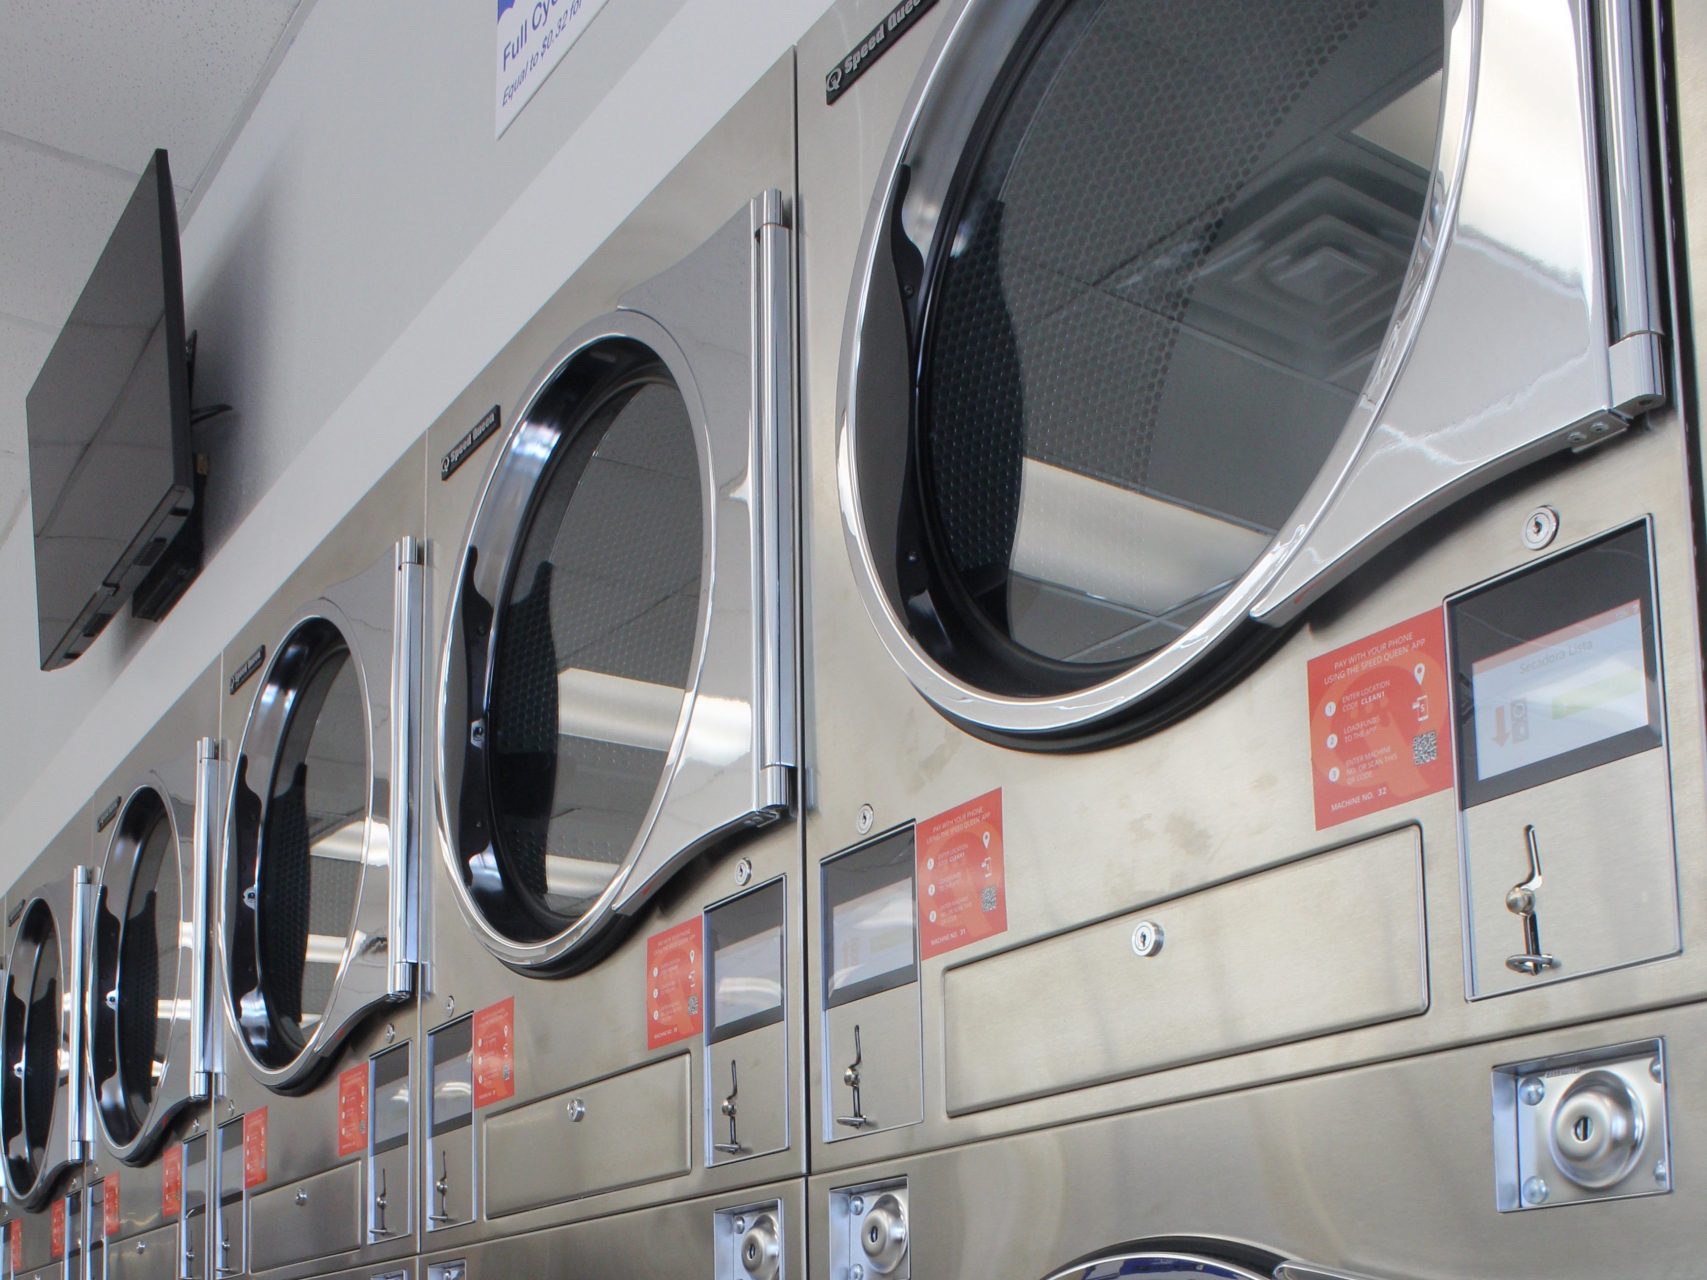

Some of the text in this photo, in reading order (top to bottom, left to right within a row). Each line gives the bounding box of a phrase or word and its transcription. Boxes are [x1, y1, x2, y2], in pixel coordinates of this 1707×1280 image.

[502, 60, 529, 107] Equal
[530, 53, 539, 72] to
[541, 10, 568, 59] $0.32
[503, 19, 527, 72] Full
[844, 23, 885, 74] Speed
[450, 433, 472, 463] Speed
[472, 412, 495, 440] Queen
[1324, 670, 1345, 685] USING
[1346, 665, 1359, 676] THE
[1360, 656, 1383, 671] SPEED
[1411, 639, 1425, 651] APP
[1334, 632, 1414, 670] PAY WITH YOUR PHONE
[1520, 640, 1593, 675] Secadora Lista
[1361, 679, 1390, 696] LOCATION
[1331, 796, 1360, 812] MACHINE
[1377, 787, 1387, 796] 32
